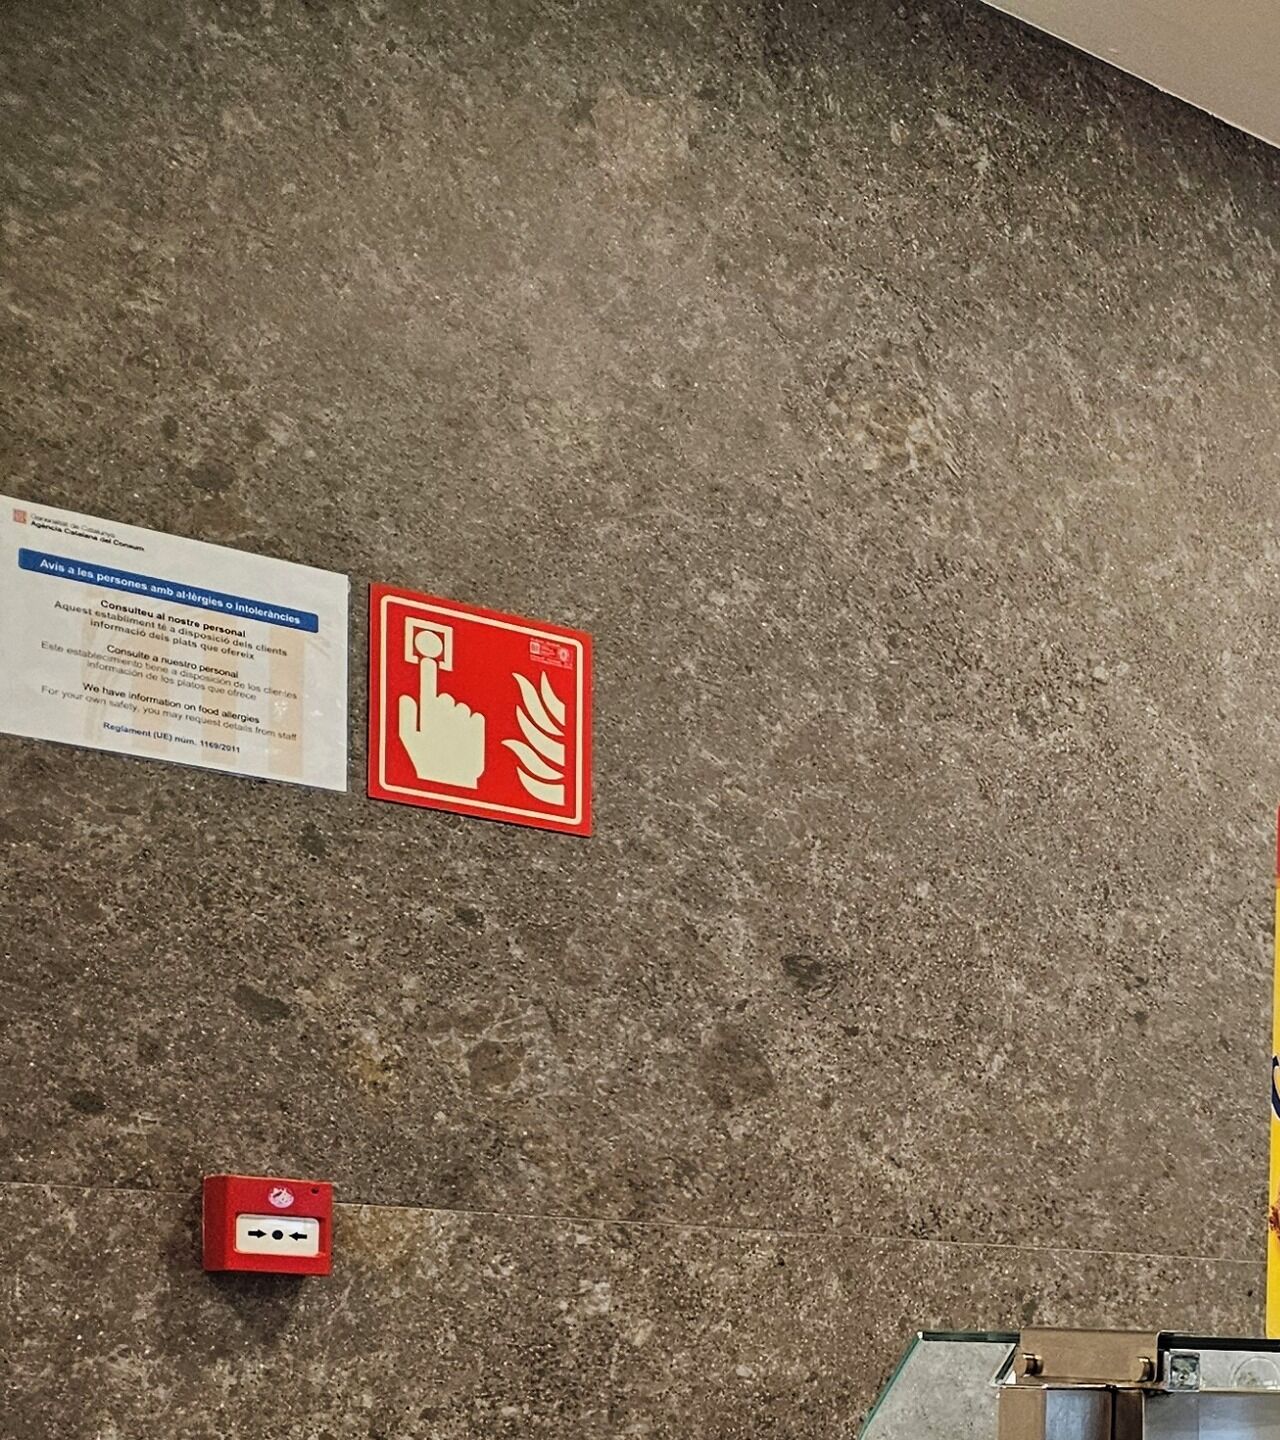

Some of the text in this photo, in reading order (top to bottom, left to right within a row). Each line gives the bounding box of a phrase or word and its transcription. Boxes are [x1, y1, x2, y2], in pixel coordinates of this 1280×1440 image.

[67, 566, 75, 575] a
[78, 566, 94, 579] les
[96, 572, 148, 591] persones
[150, 582, 174, 598] amb
[225, 602, 233, 610] o
[235, 601, 300, 625] intoleràncies
[54, 600, 92, 616] Aquest
[94, 608, 155, 629] establiment
[157, 622, 167, 631] té
[178, 625, 230, 645] disposició
[232, 639, 253, 649] dels
[255, 644, 288, 657] clients
[90, 619, 255, 660] informació dels plats que ofereix
[100, 599, 246, 638] Consulteu al nostre personal
[41, 640, 64, 653] Este
[66, 647, 143, 670] establecimiento
[180, 667, 231, 687] disposición
[233, 680, 245, 690] de
[247, 682, 261, 693] los
[87, 659, 257, 701] información de los platos que ofrece
[106, 644, 150, 660] Consulte
[161, 656, 198, 670] nuestro
[199, 662, 239, 679] personal
[41, 685, 297, 741] For your own safety, you may request details from staff
[82, 682, 260, 724] We have information on food allergies
[103, 721, 151, 737] Reglament
[153, 730, 172, 743] (UE)
